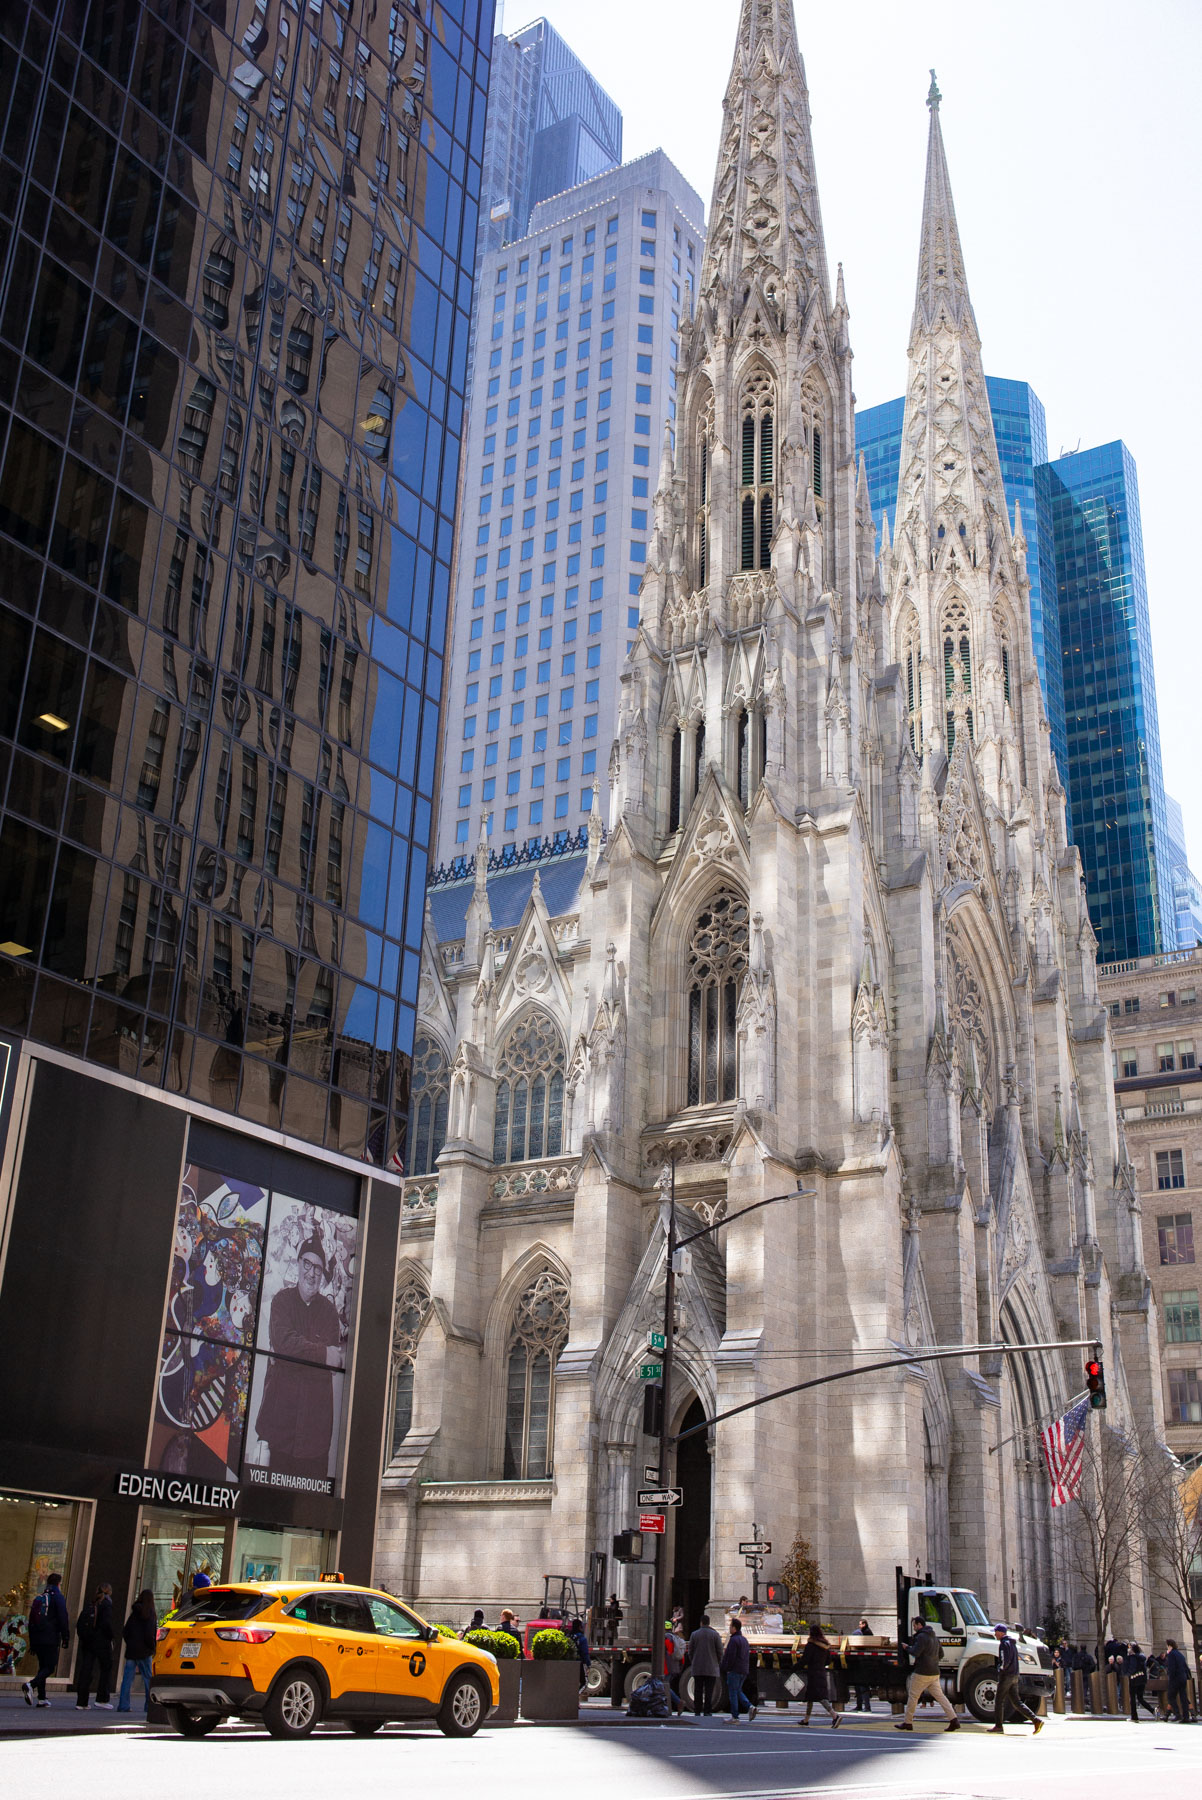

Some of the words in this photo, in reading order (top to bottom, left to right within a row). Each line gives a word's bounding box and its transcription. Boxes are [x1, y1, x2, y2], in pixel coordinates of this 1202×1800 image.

[653, 1334, 658, 1345] 5
[640, 1366, 645, 1377] E
[647, 1366, 654, 1377] 51
[249, 1468, 270, 1484] YOEL
[271, 1472, 332, 1494] BENHARROUCHE
[118, 1473, 165, 1500] EDEN
[167, 1481, 240, 1510] GALLERY
[641, 1495, 655, 1503] ONE
